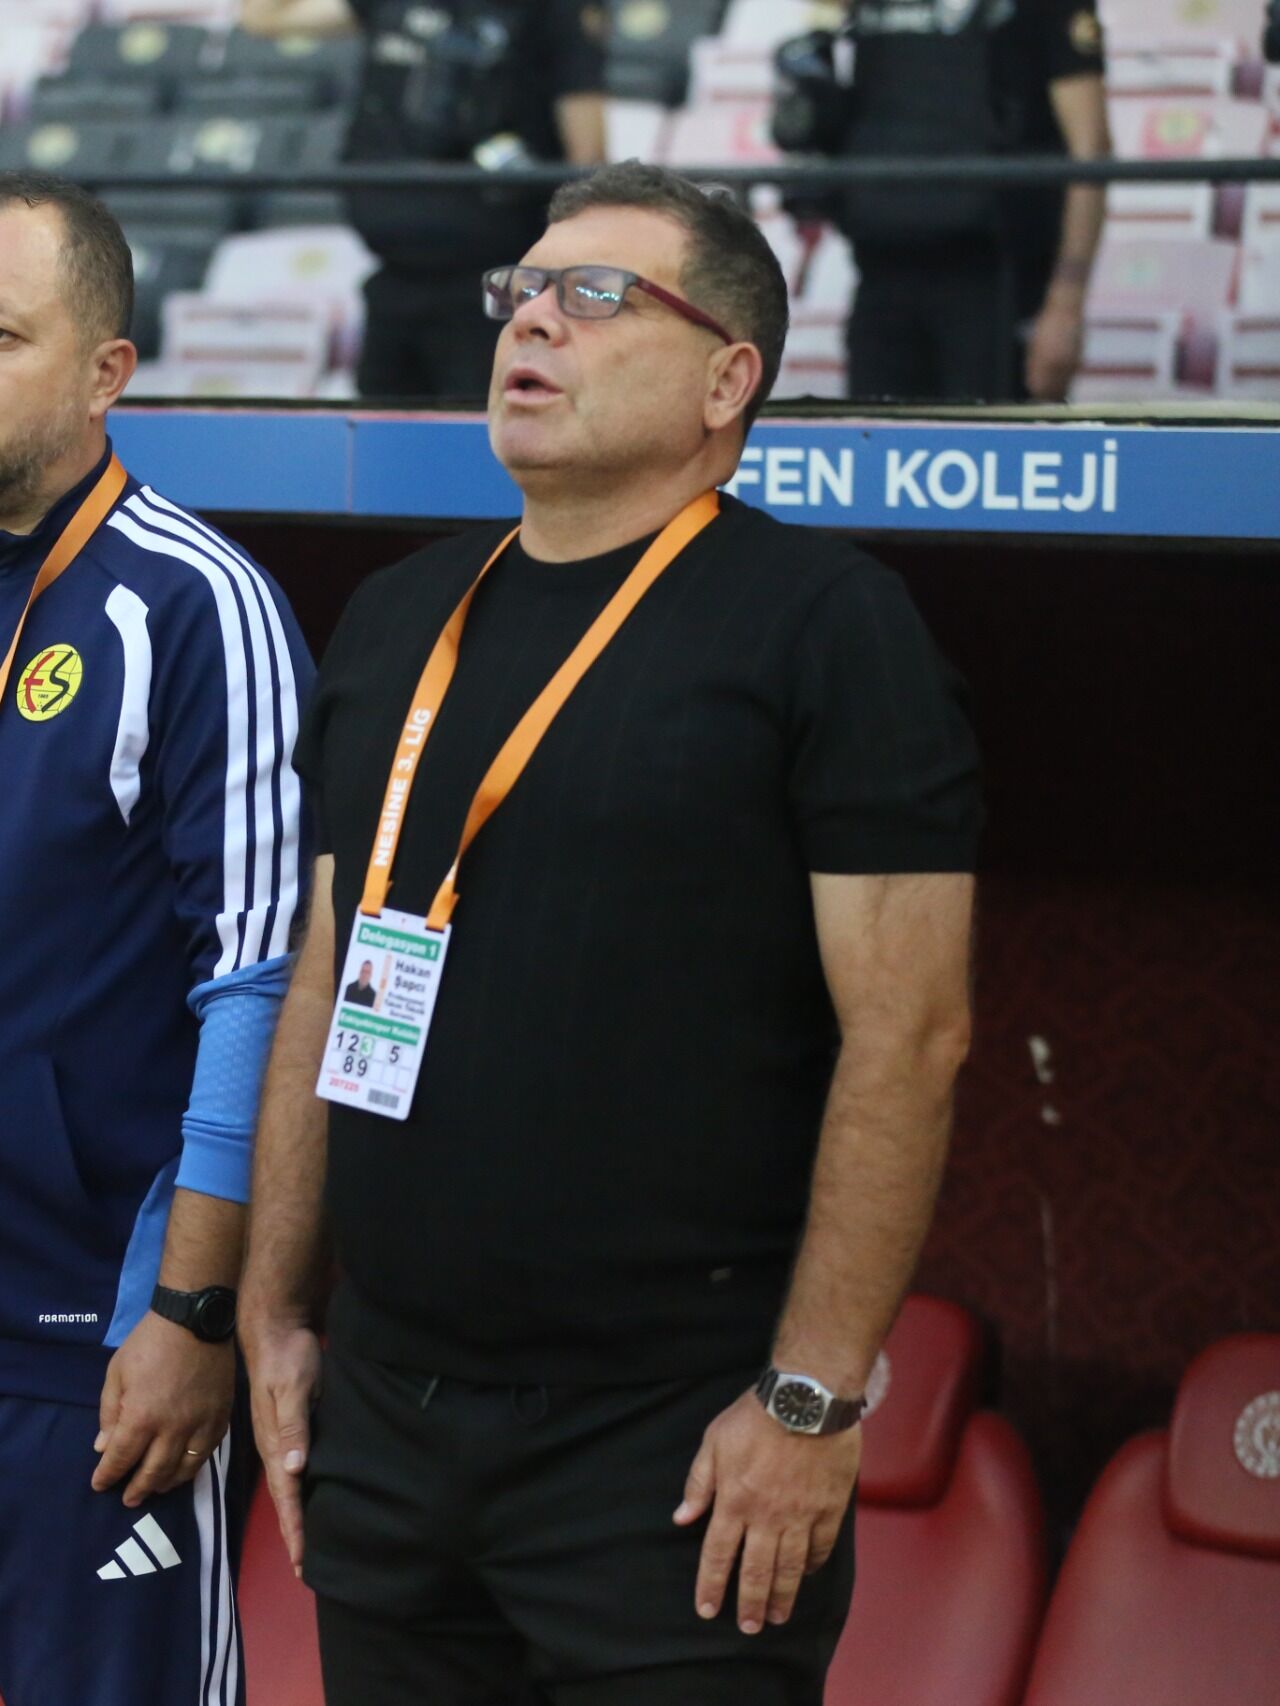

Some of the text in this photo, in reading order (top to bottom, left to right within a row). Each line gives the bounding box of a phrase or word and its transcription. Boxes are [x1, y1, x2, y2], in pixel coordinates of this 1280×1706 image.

[725, 438, 1117, 513] FEN KOLEJİ
[374, 778, 408, 867] NESİNE
[405, 708, 432, 746] LİG
[395, 959, 431, 978] Hakan
[389, 1045, 400, 1064] 5
